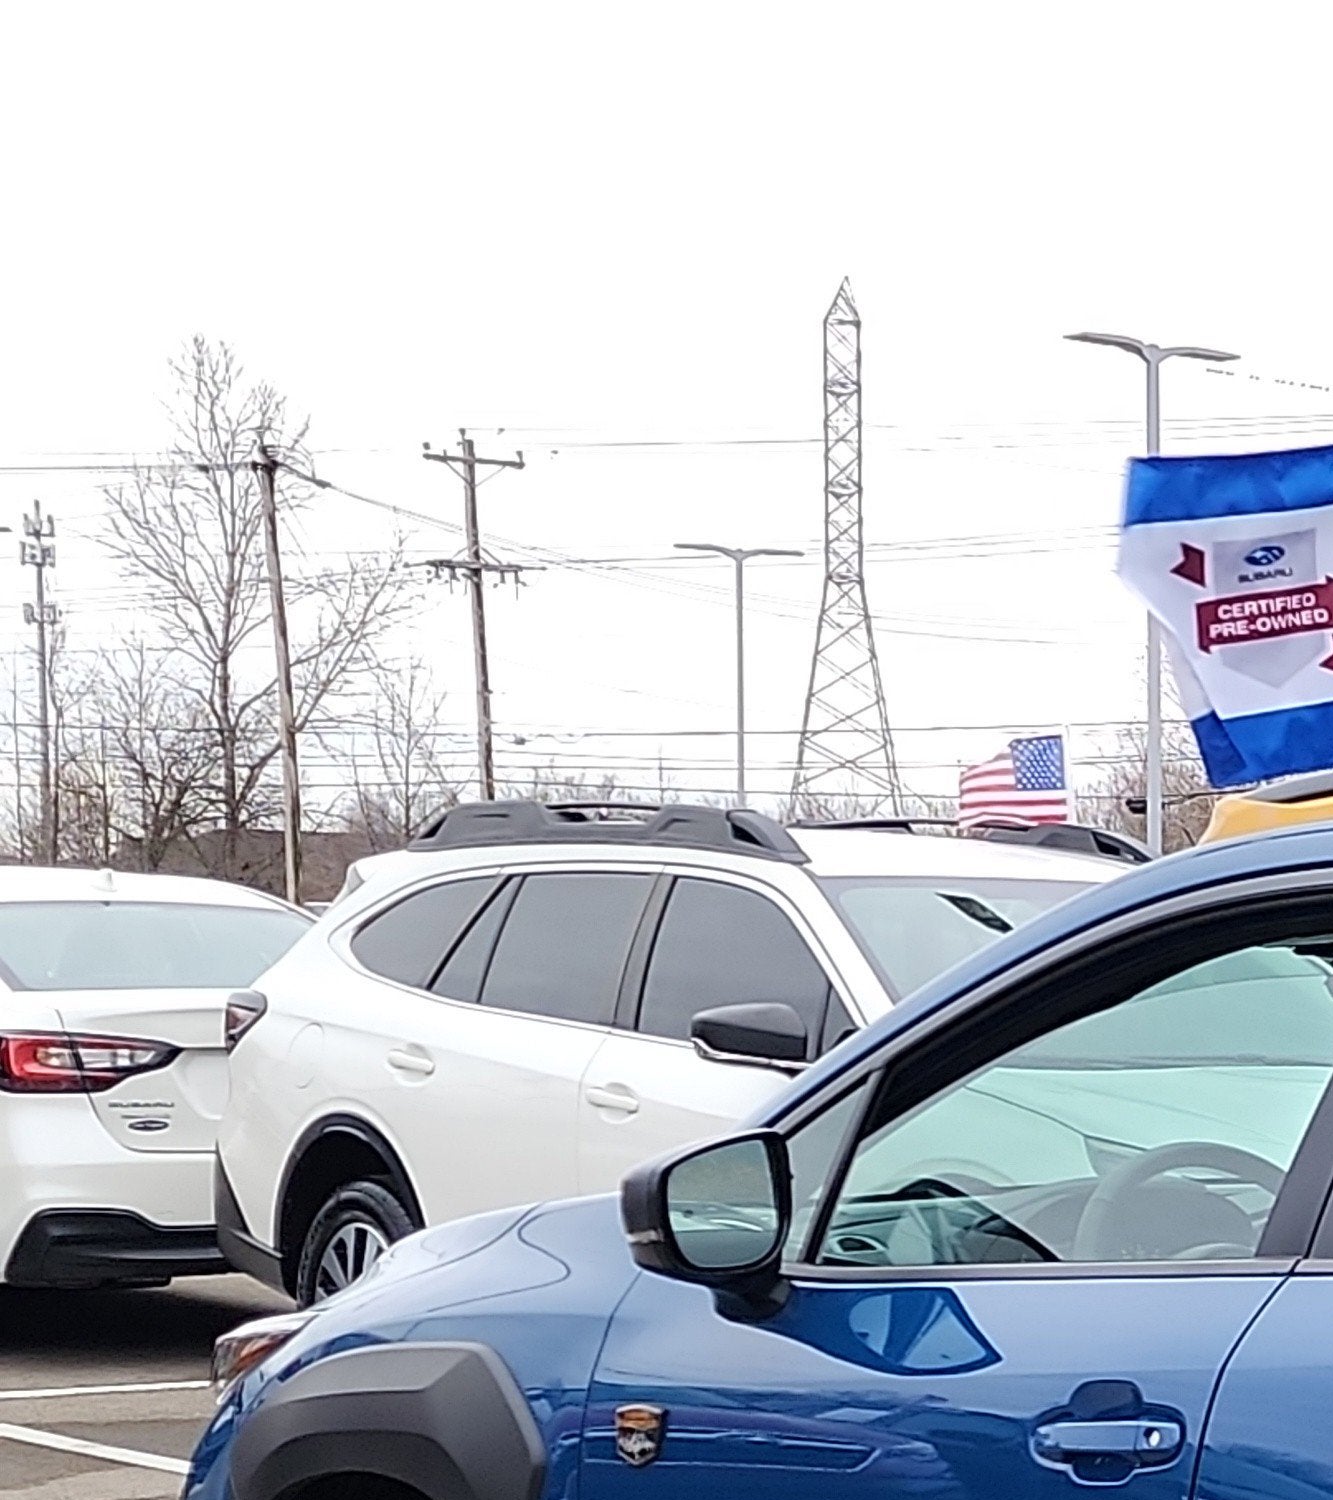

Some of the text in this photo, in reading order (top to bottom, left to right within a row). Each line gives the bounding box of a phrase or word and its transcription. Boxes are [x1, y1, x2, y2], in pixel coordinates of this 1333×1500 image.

[1238, 567, 1293, 584] SUBARU
[1217, 592, 1316, 620] CERTIFIED
[1208, 608, 1330, 639] PRE-OWNED
